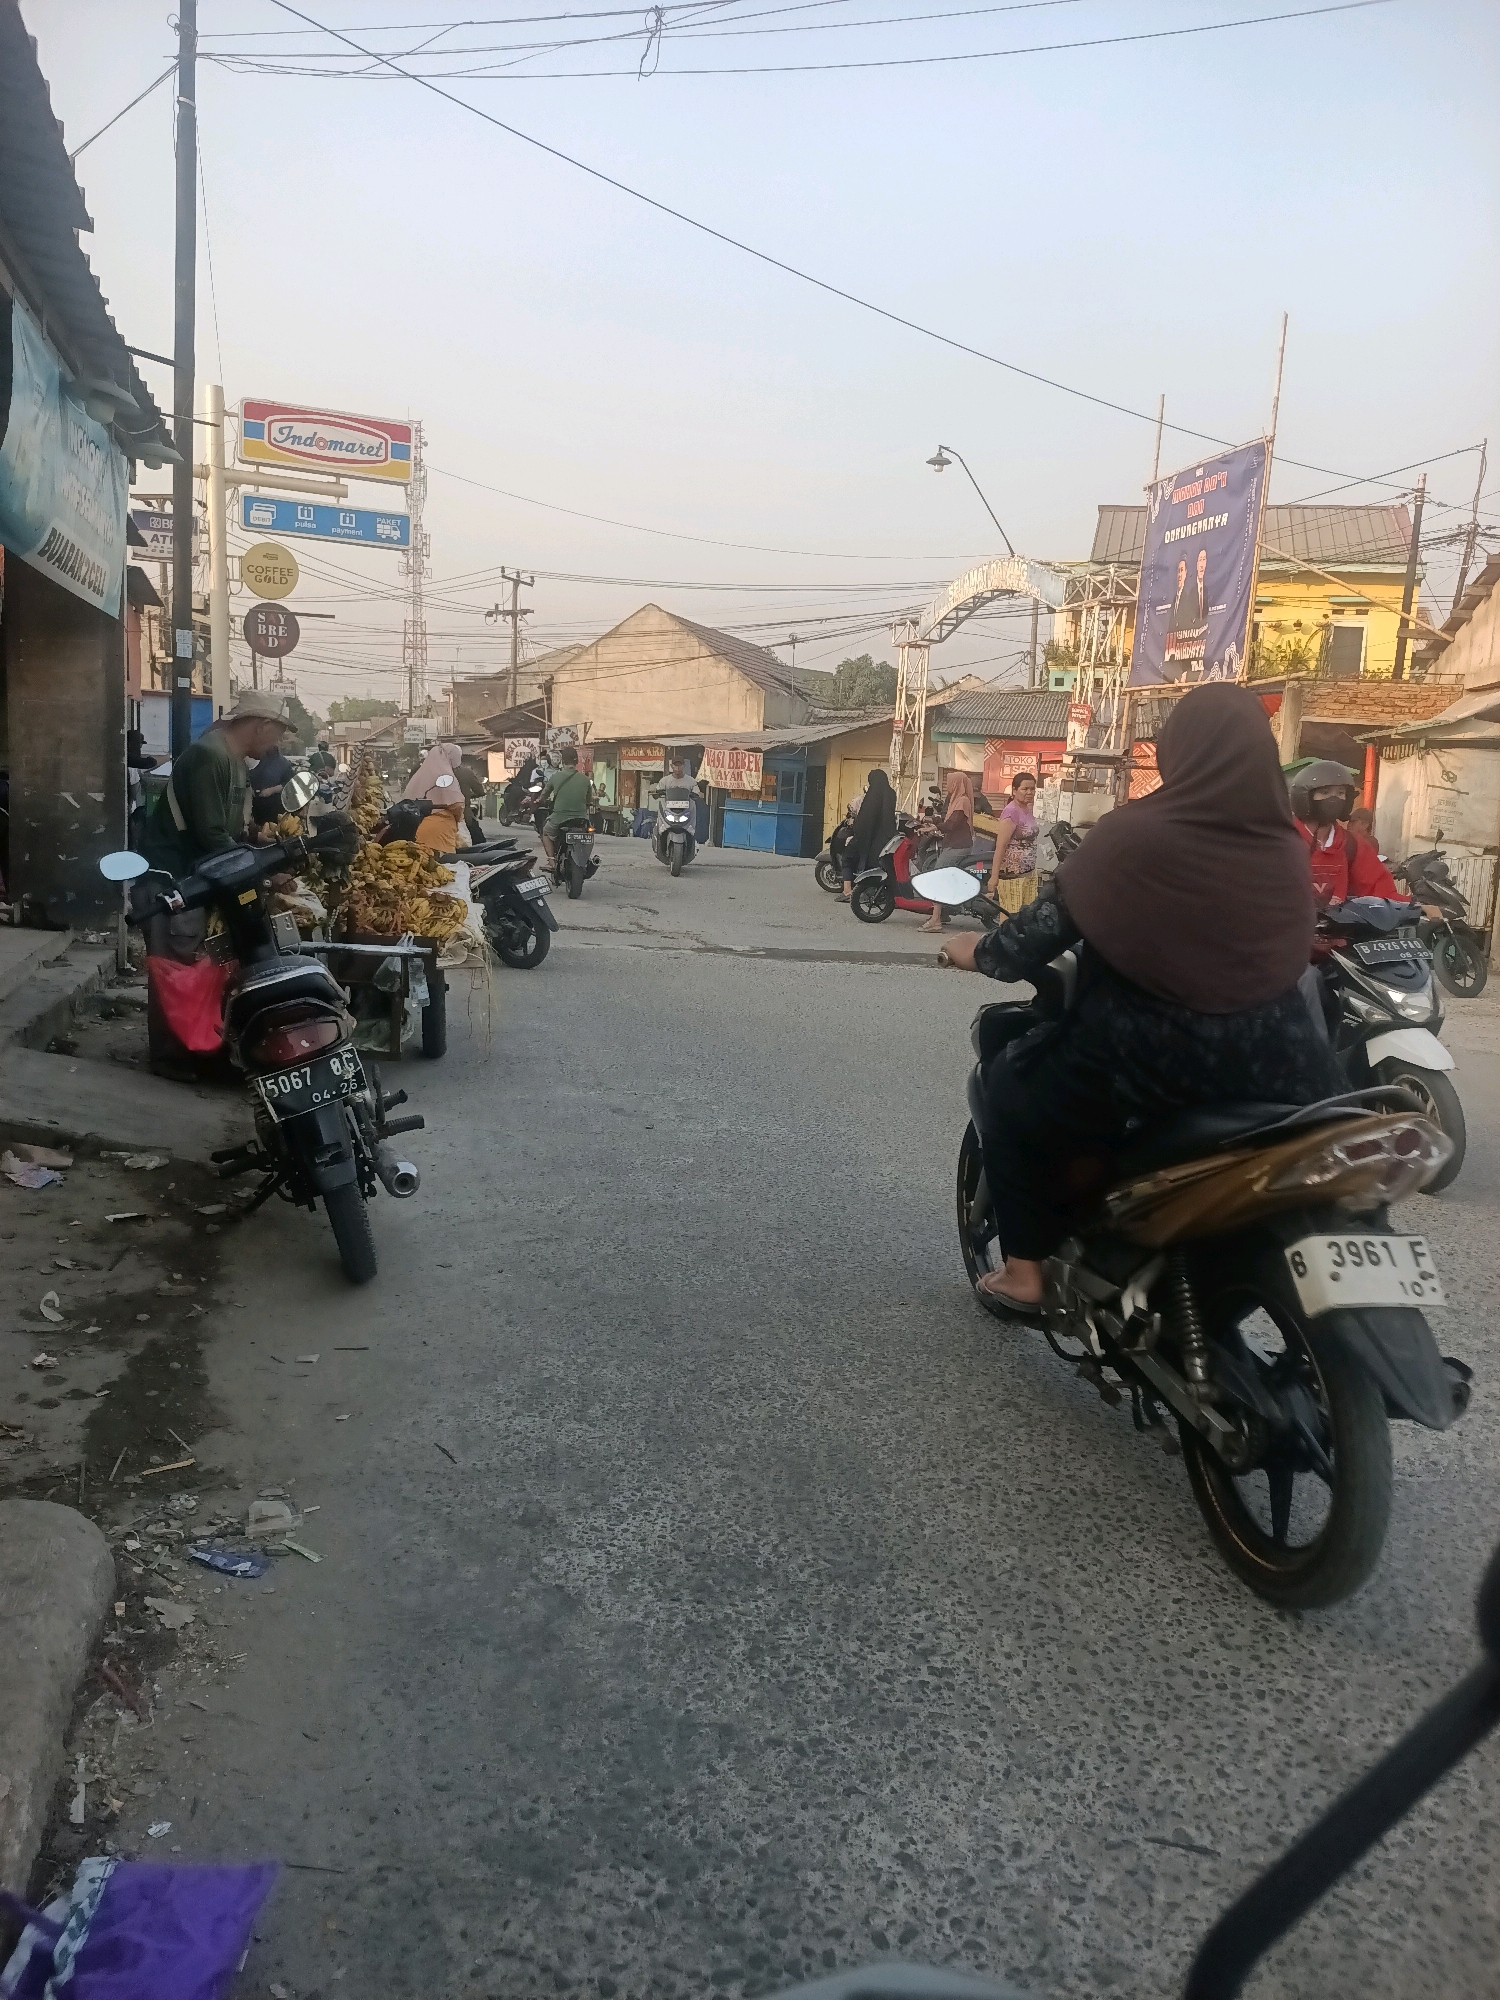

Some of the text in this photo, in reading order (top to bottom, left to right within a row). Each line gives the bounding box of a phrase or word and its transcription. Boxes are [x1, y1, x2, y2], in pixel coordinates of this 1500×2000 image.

[273, 425, 384, 458] Indomaret
[294, 521, 317, 529] pulsa
[376, 517, 402, 527] PAKET
[331, 527, 364, 536] payment
[150, 533, 173, 545] AT
[246, 564, 294, 577] COFFEE
[254, 574, 289, 585] GOLD
[727, 751, 762, 773] BEBEK
[1007, 755, 1034, 764] TOKO
[715, 770, 743, 781] AYAM
[1359, 945, 1371, 954] B
[265, 1066, 312, 1098] 5067
[1290, 1240, 1427, 1278] B 3961 F
